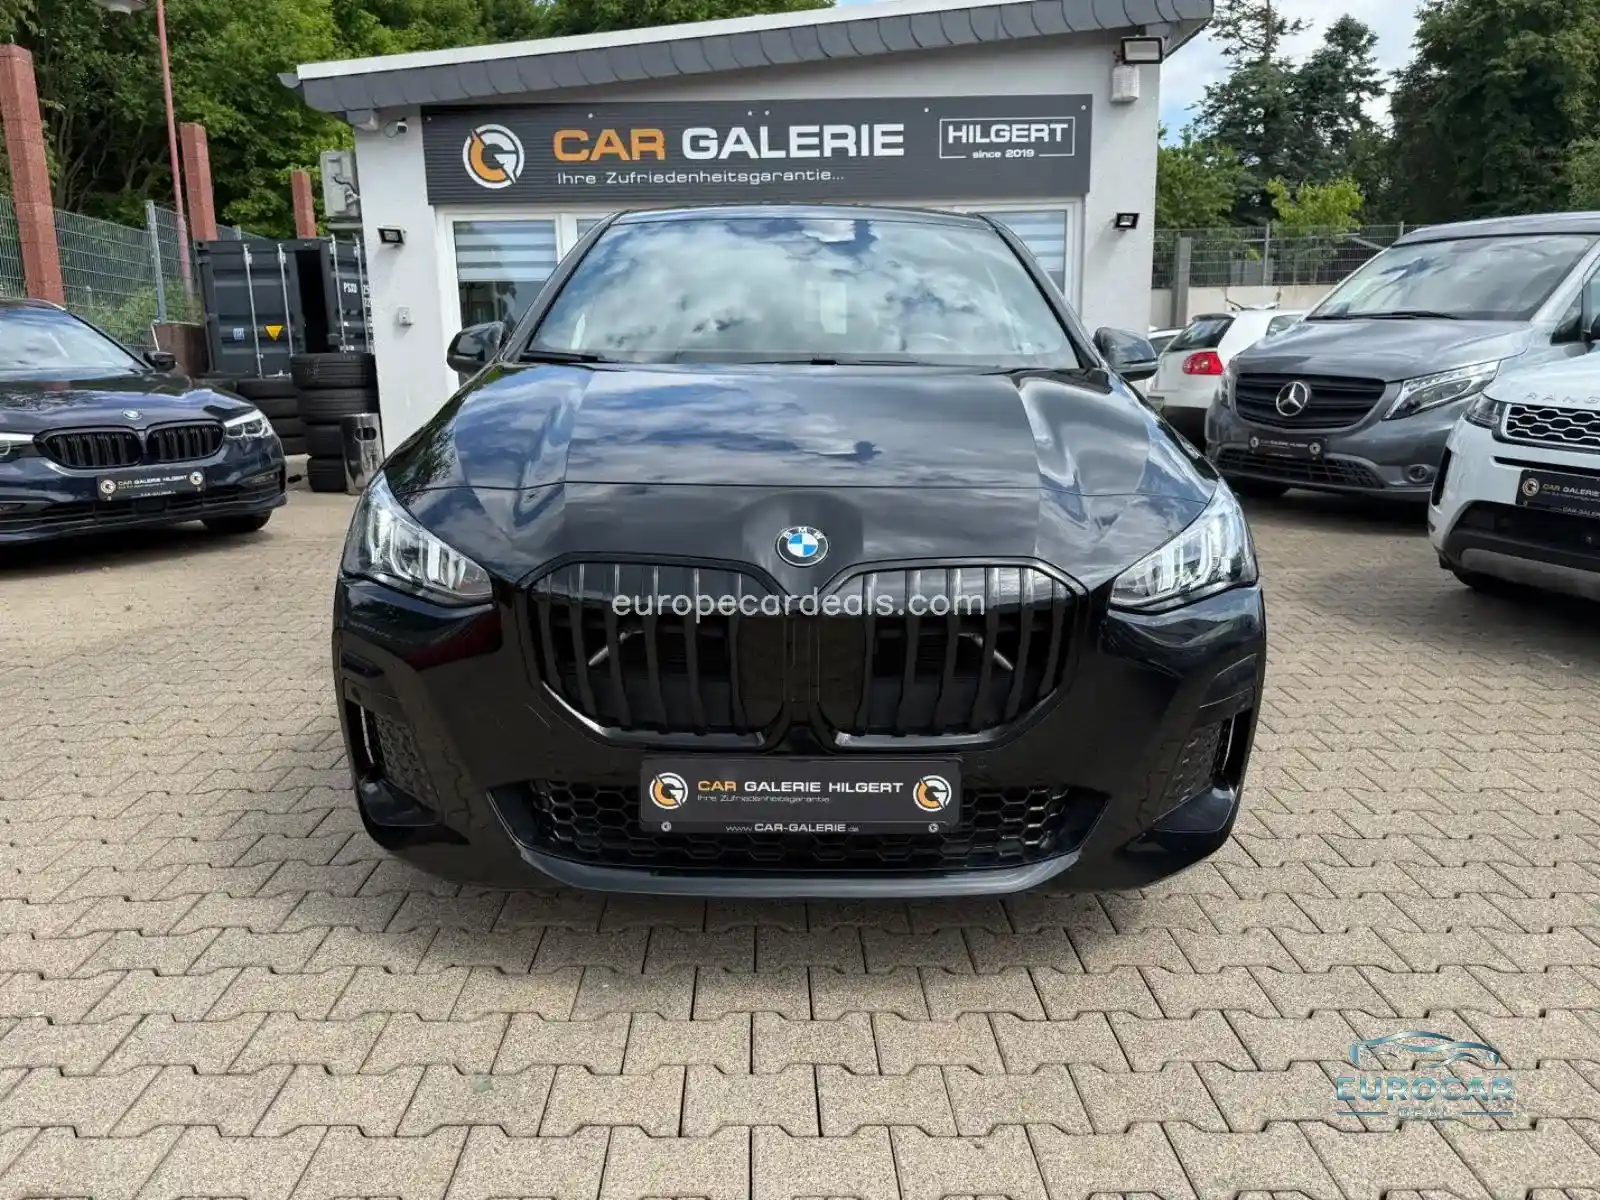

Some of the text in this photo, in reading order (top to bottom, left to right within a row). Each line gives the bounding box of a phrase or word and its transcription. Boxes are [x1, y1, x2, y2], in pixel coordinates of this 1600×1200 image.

[948, 123, 1068, 144] HILGERT
[553, 124, 905, 162] CAR GALERIE
[972, 148, 1035, 158] since 2019
[558, 172, 597, 185] Ihre
[783, 527, 825, 540] BMW
[697, 780, 904, 793] CAR GALERIE HILGERT
